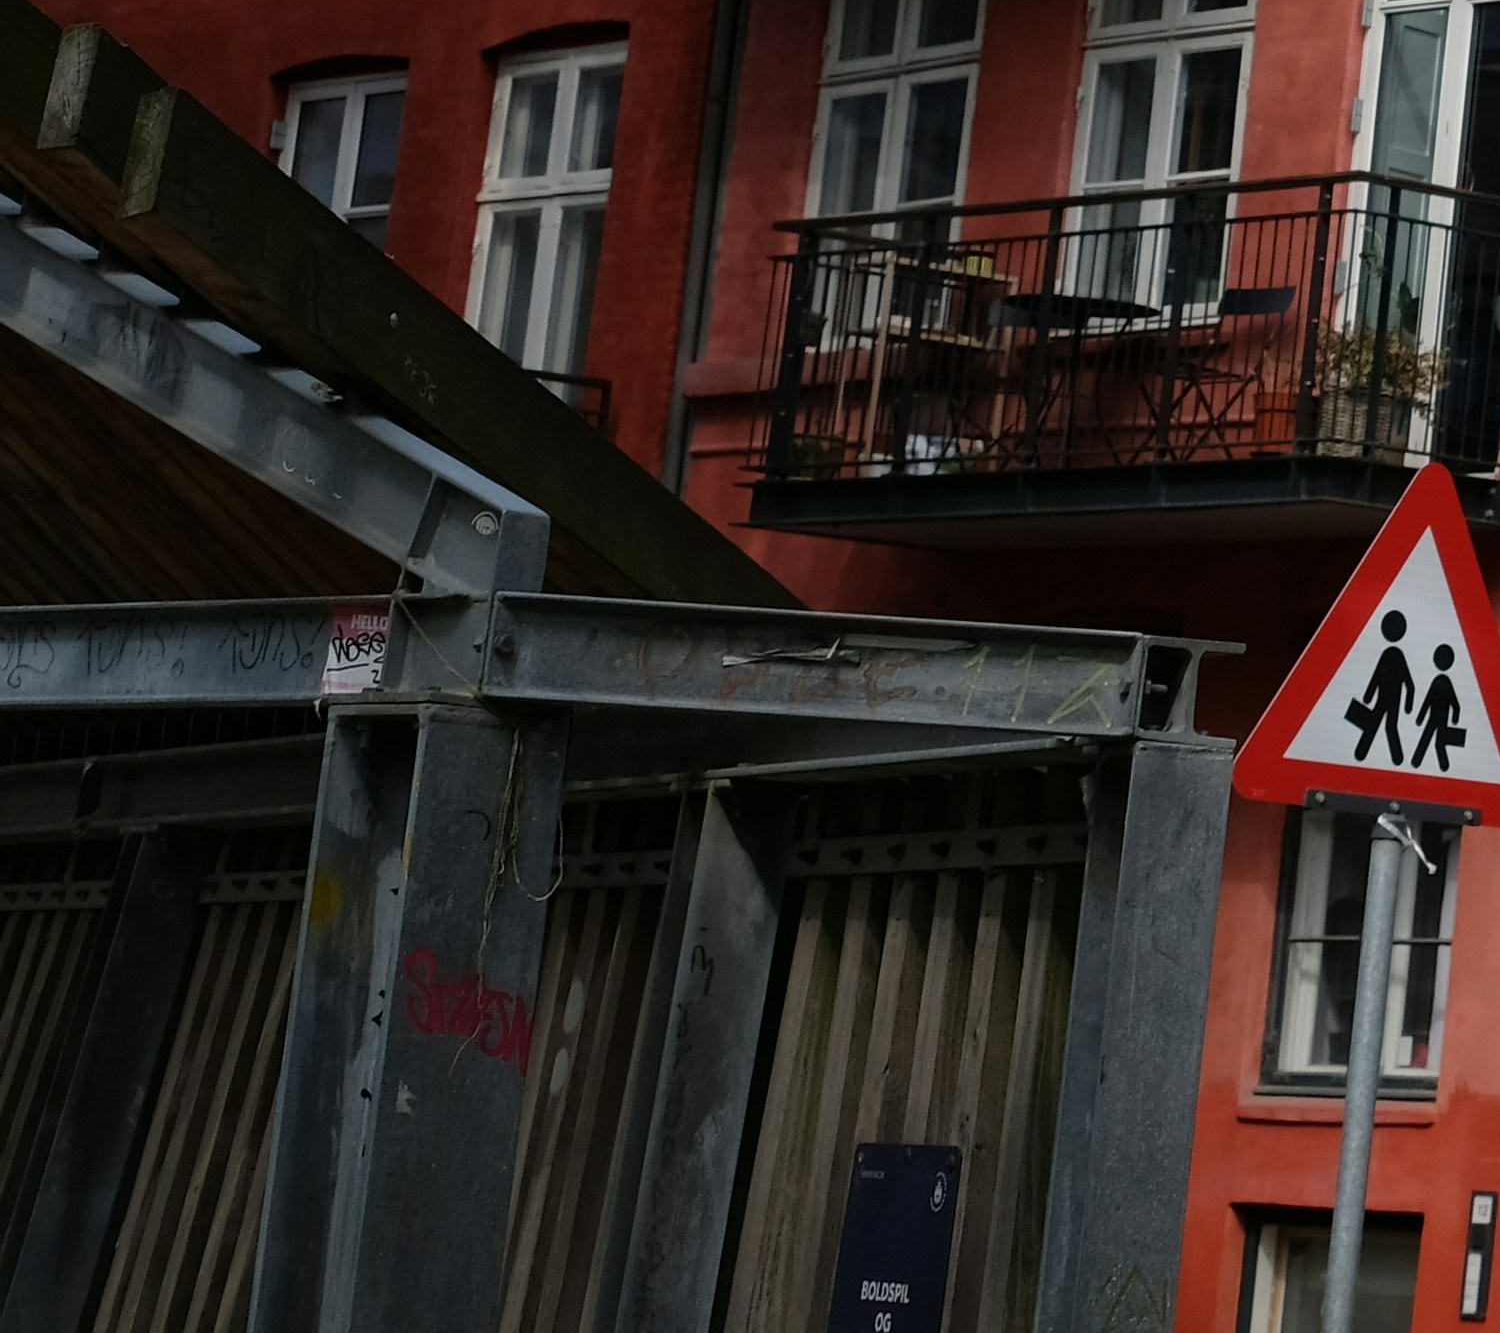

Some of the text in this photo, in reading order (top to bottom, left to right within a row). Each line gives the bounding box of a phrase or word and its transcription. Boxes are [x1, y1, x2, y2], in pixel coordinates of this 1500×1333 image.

[351, 614, 389, 631] HELLO
[860, 1280, 911, 1304] BOLDSPIL
[874, 1312, 892, 1333] OG
